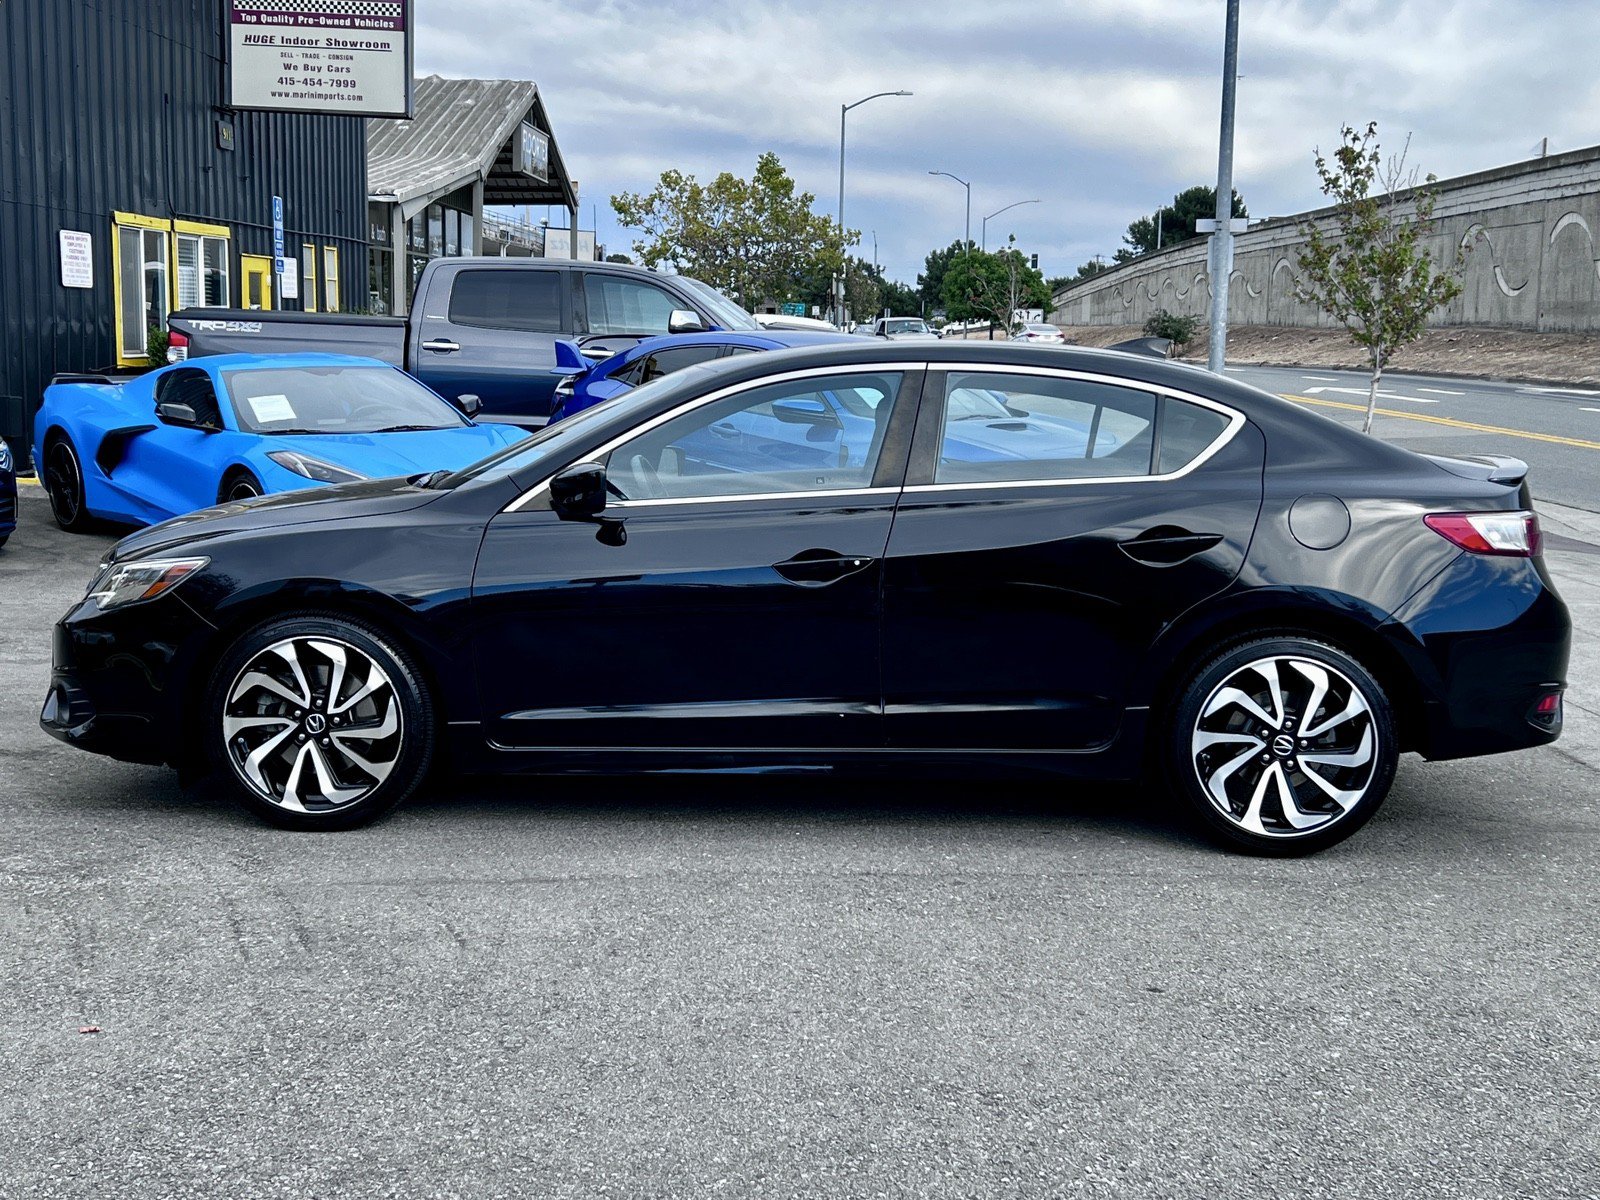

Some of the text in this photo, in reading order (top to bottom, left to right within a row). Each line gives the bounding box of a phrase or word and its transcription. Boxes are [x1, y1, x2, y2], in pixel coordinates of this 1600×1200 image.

[240, 12, 395, 29] Top Quality Pre-Owned Vehicles
[244, 34, 391, 49] HUGE Indoor Showroom
[280, 51, 294, 59] SELL
[301, 52, 320, 60] TRADE
[328, 53, 354, 61] CONSIGN
[283, 62, 351, 74] We Buy Cars
[277, 76, 357, 89] 415-454-7999
[270, 91, 363, 101] www.marinimports.com
[188, 320, 226, 331] TRD
